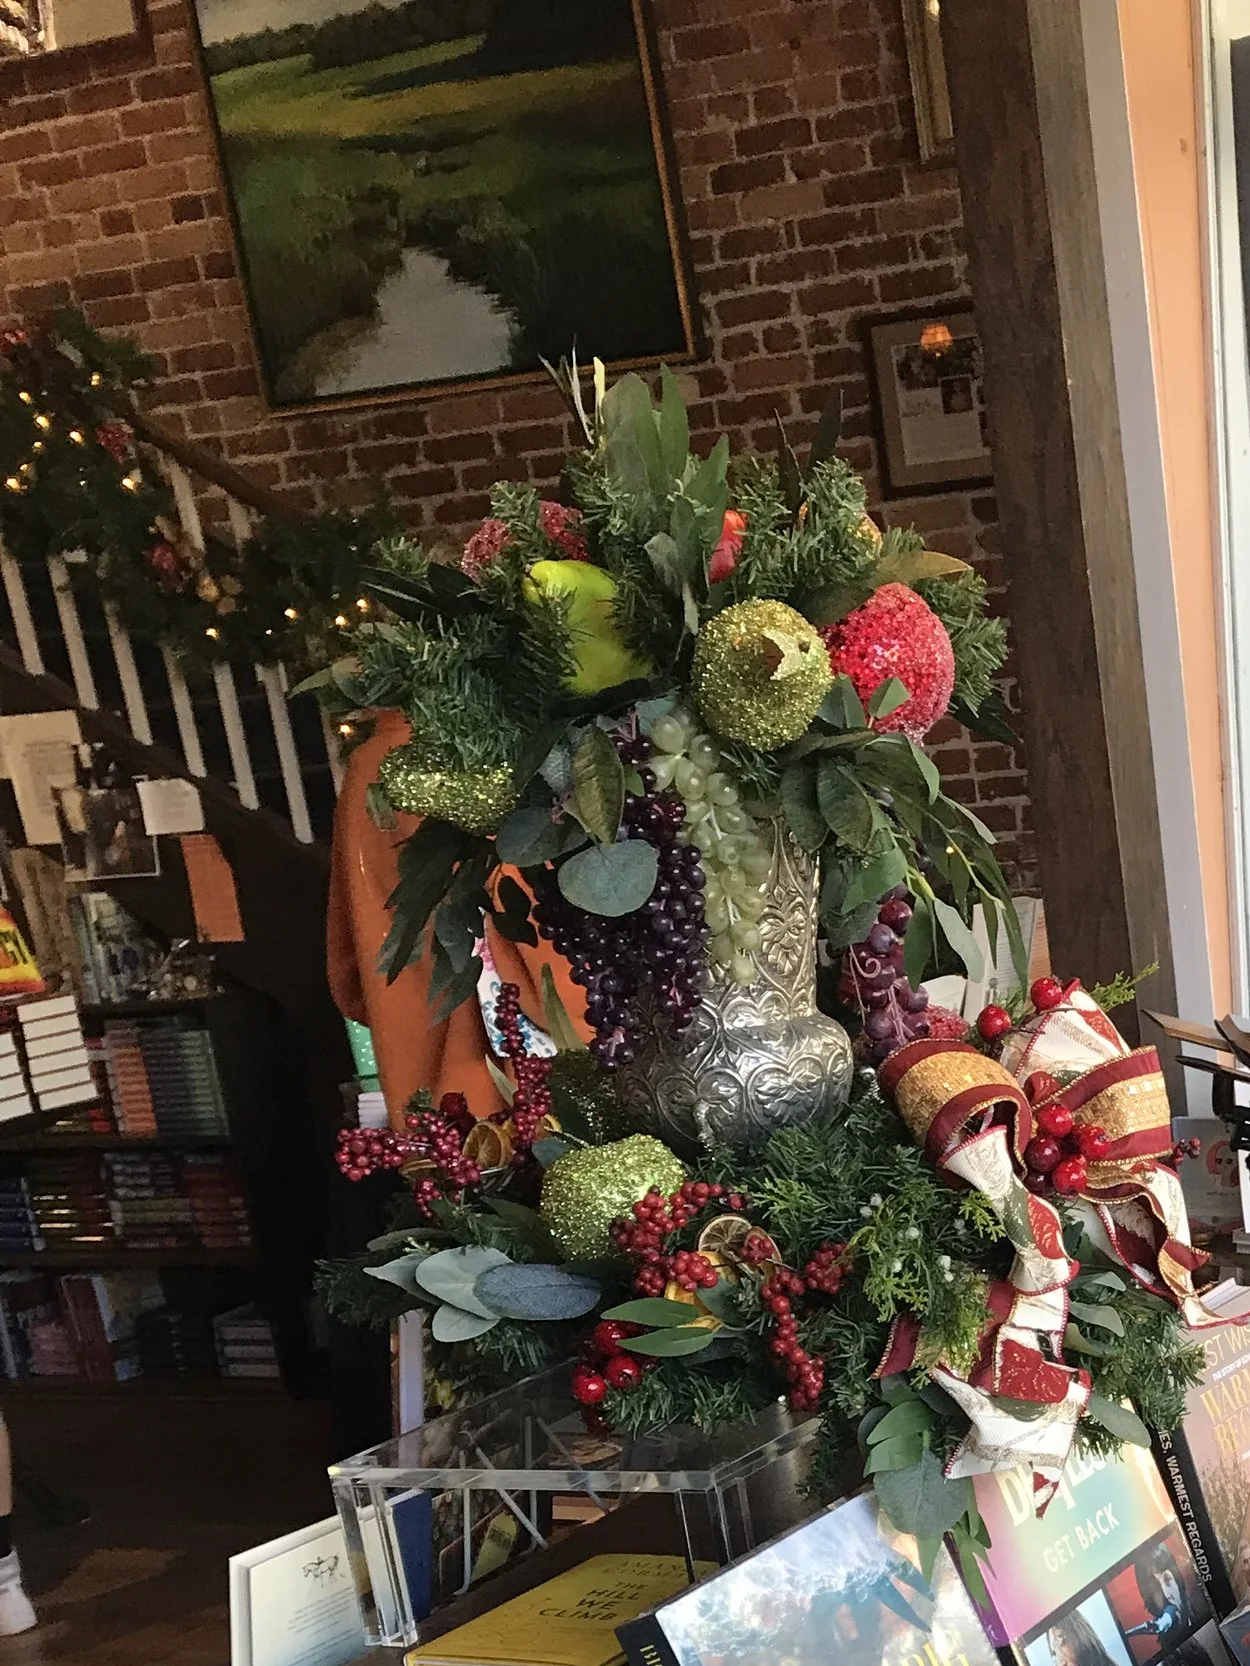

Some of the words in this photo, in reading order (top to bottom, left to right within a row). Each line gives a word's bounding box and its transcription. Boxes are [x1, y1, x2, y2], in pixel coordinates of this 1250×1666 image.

[1165, 1455, 1193, 1519] WARMEST
[1185, 1521, 1213, 1583] REGARDS
[1044, 1534, 1076, 1573] GET
[1074, 1502, 1121, 1551] BACK
[614, 1581, 649, 1591] THE
[586, 1588, 642, 1601] HILL
[575, 1598, 622, 1611] WE
[538, 1608, 619, 1621] CLIMB
